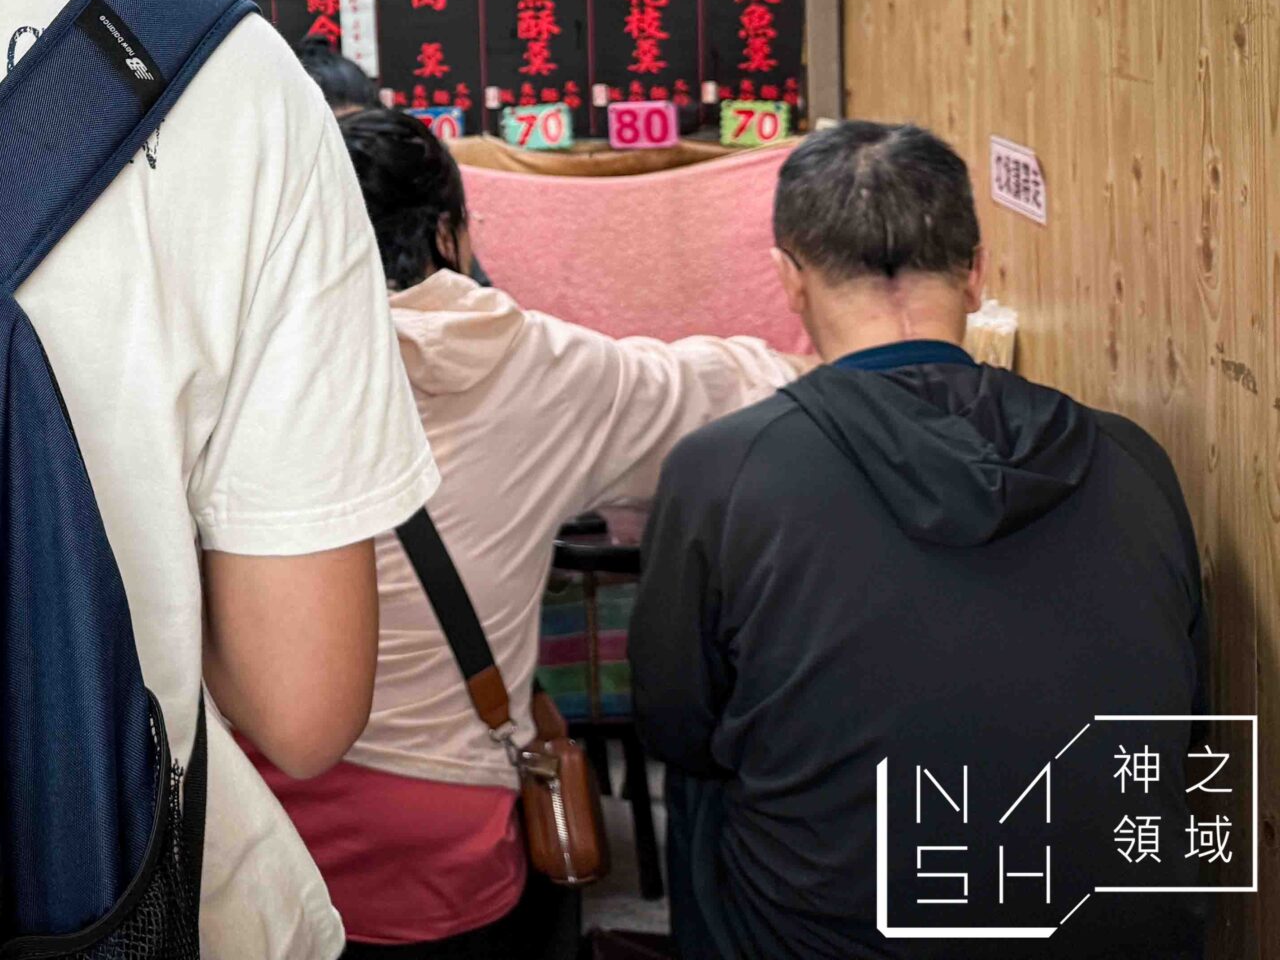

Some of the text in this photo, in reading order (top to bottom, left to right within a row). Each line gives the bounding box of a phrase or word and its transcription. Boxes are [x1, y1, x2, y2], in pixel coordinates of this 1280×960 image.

[99, 15, 136, 56] new balance
[515, 110, 564, 147] 70
[615, 108, 670, 145] 80
[732, 108, 779, 142] 70
